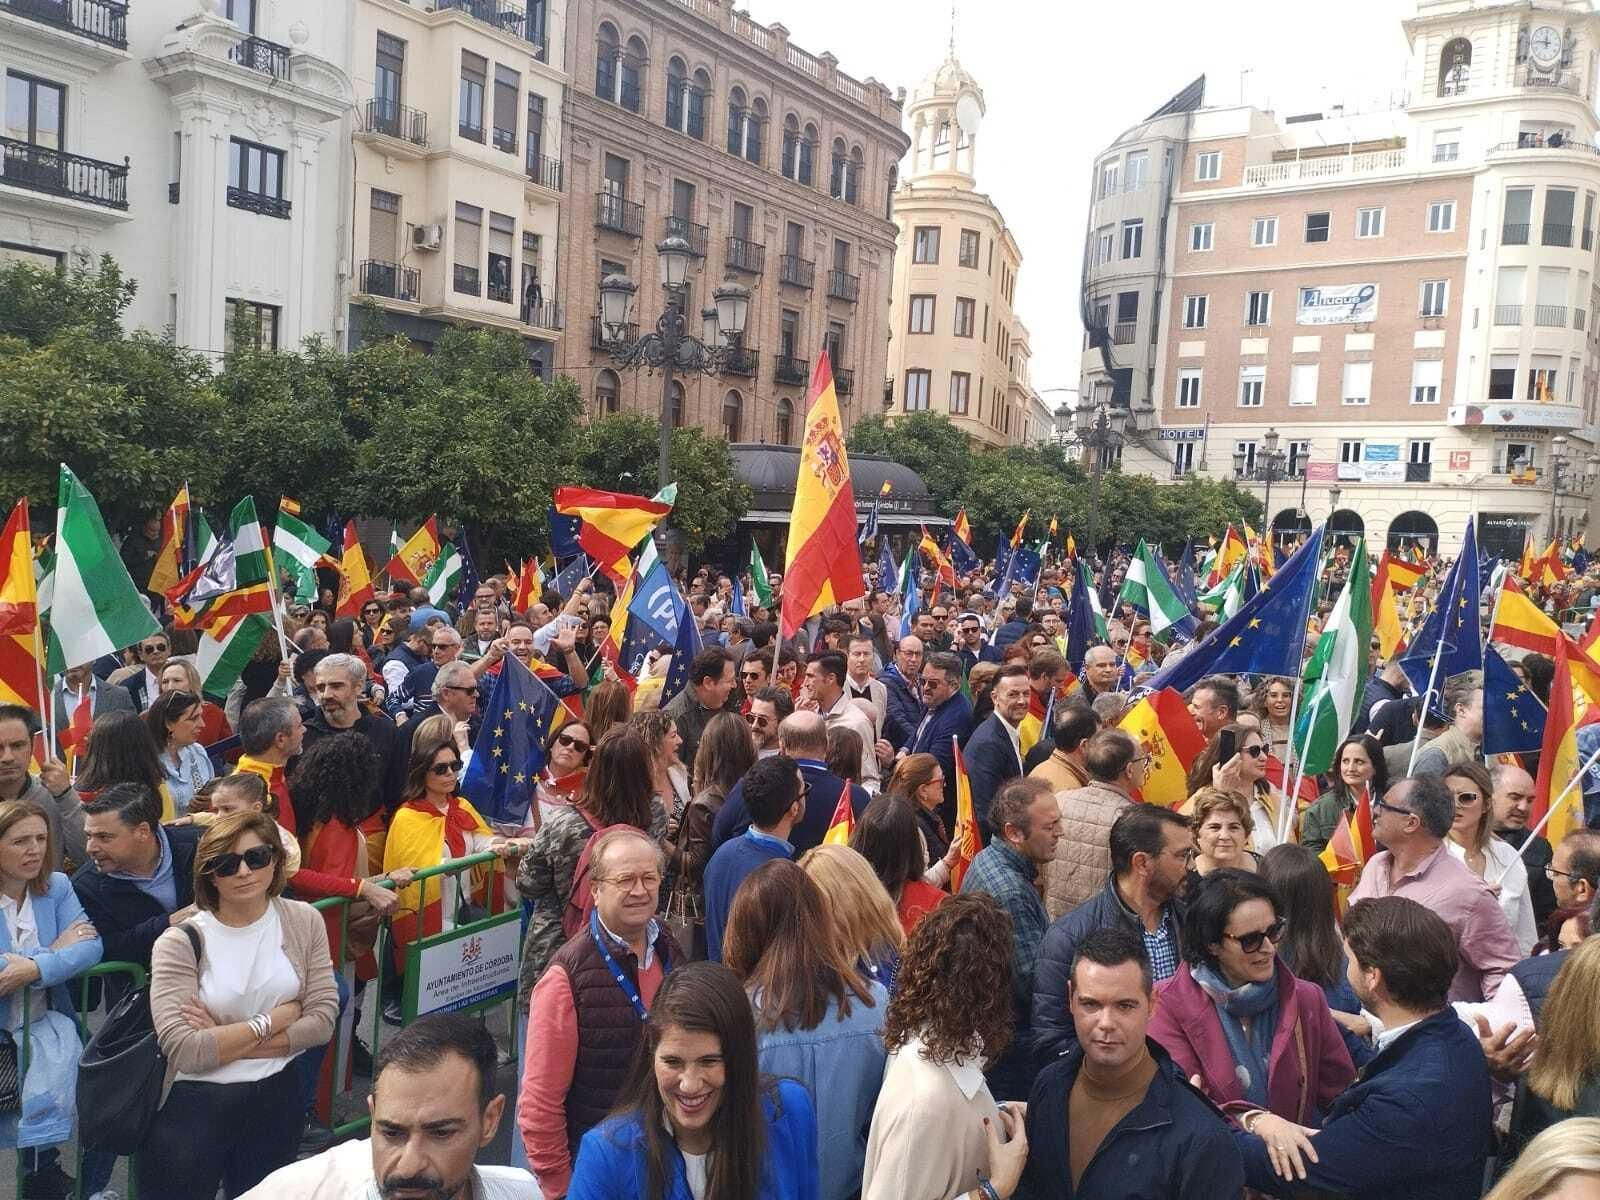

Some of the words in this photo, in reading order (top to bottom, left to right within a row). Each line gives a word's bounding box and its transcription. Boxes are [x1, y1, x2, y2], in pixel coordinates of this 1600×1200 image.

[1158, 429, 1205, 440] HOTEL
[426, 967, 474, 992] AYUNTAMIENTO
[475, 963, 485, 975] DE
